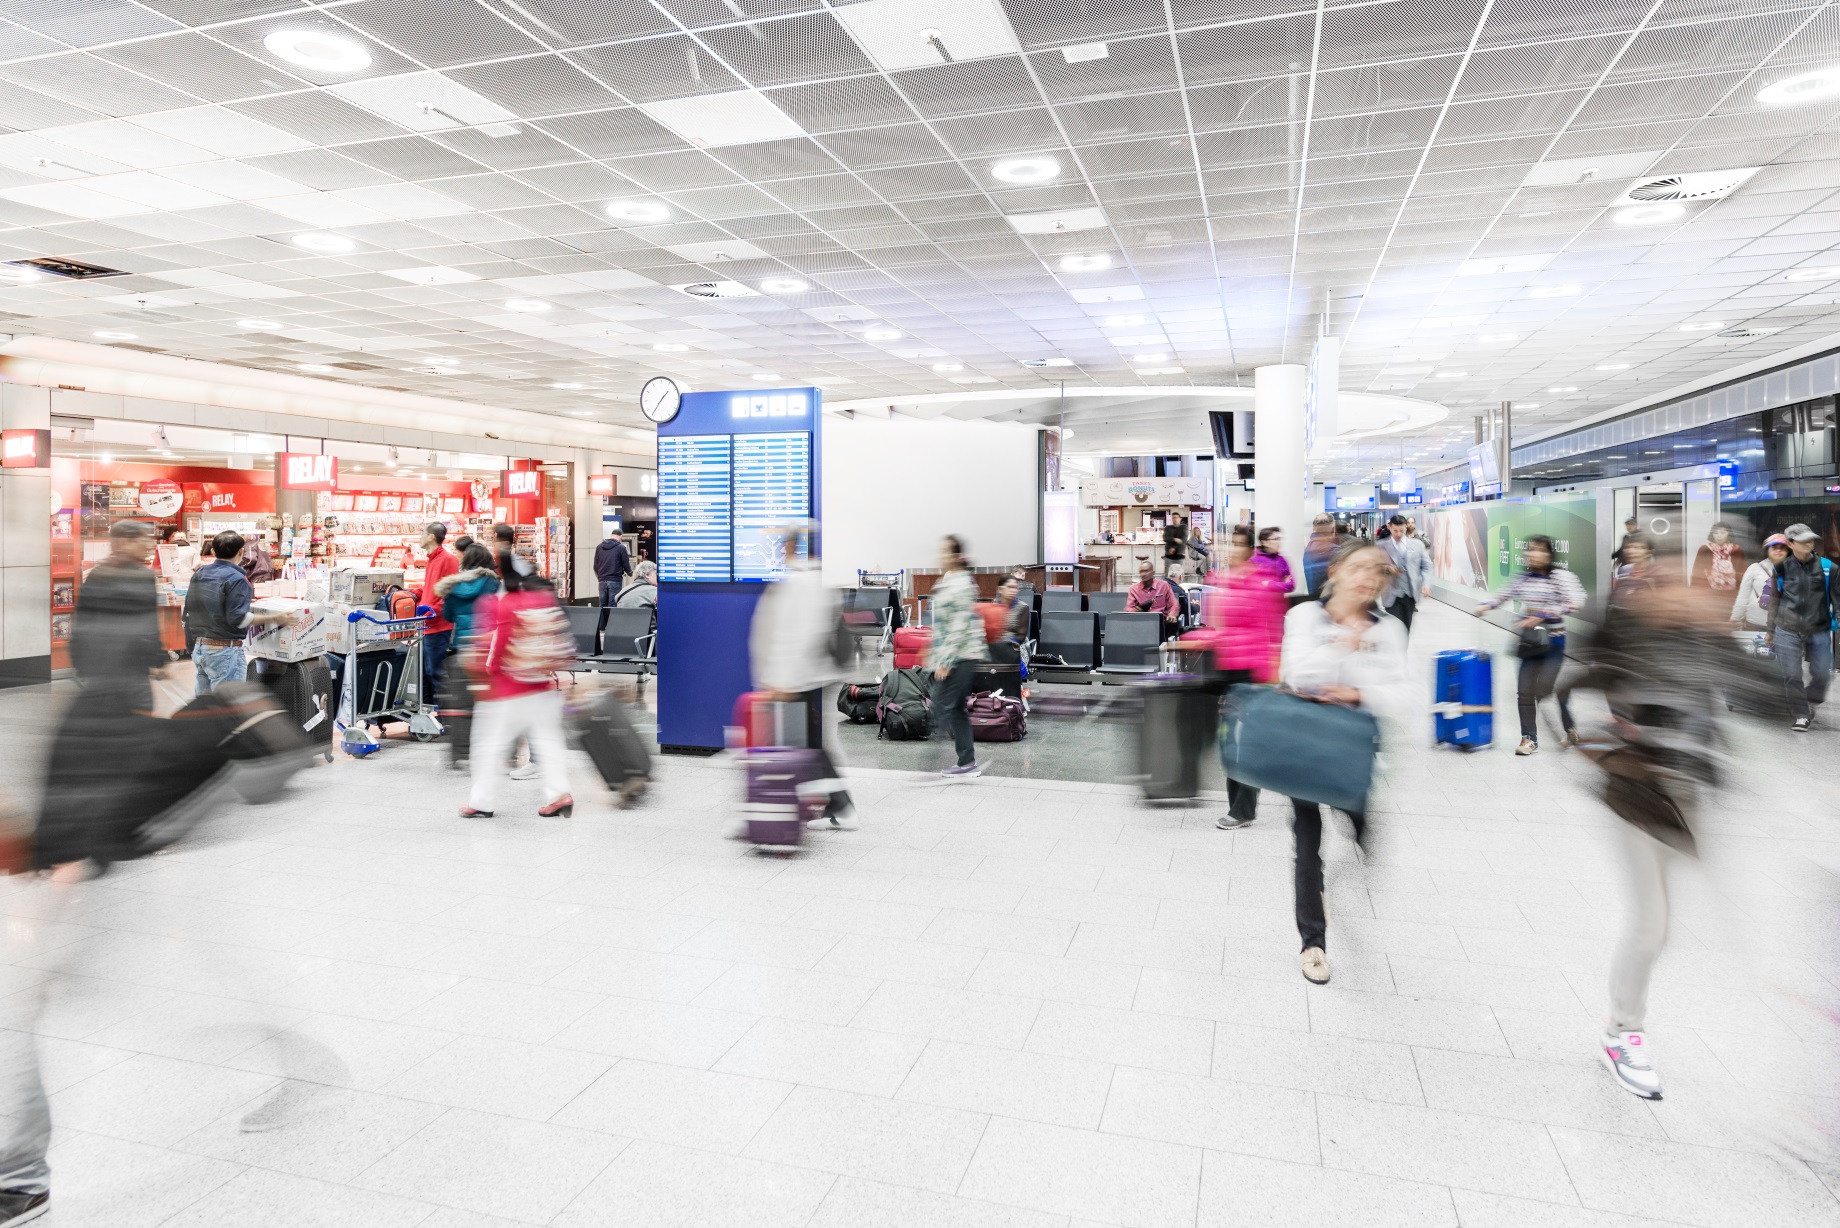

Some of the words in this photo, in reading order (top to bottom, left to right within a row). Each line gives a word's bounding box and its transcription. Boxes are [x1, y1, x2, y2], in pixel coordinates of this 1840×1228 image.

[288, 455, 334, 484] RELAY
[508, 471, 538, 495] RELAY
[1128, 485, 1157, 494] DONUTS
[211, 493, 235, 508] RELAY
